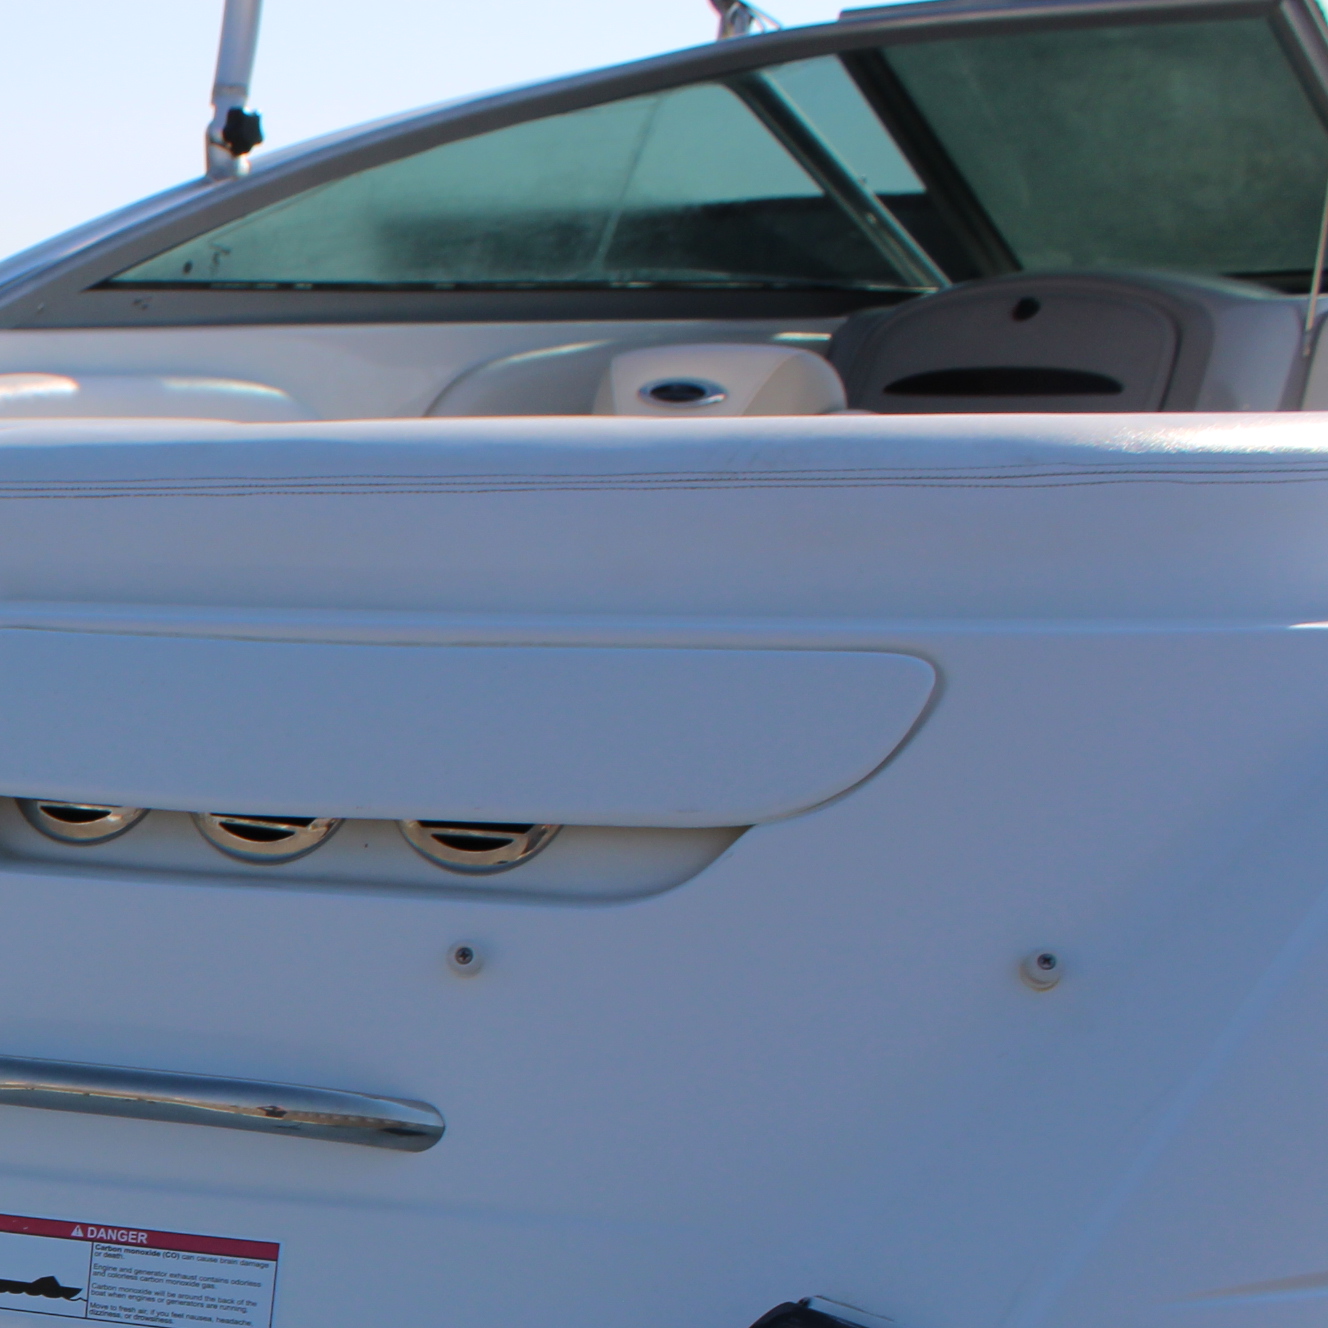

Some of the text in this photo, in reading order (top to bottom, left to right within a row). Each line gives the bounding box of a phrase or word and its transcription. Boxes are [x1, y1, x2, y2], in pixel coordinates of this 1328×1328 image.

[87, 1226, 148, 1244] DANGER
[95, 1244, 123, 1253] Carbon
[124, 1248, 160, 1257] monoxide
[162, 1251, 180, 1260] (CO)
[220, 1257, 238, 1265] brain
[240, 1260, 269, 1269] damage
[93, 1263, 117, 1272] Engine
[134, 1269, 167, 1277] generator
[169, 1272, 197, 1280] exhaust
[199, 1275, 229, 1284] contains
[230, 1279, 261, 1287] odorless
[107, 1272, 138, 1280] colorless
[140, 1275, 164, 1283] carbon
[165, 1278, 200, 1287] monoxide
[91, 1282, 117, 1291] Carbon
[118, 1286, 152, 1295] monoxide
[177, 1293, 203, 1301] around
[128, 1294, 155, 1302] engines
[166, 1298, 204, 1307] generators
[89, 1302, 109, 1310] Move
[118, 1305, 136, 1313] fresh
